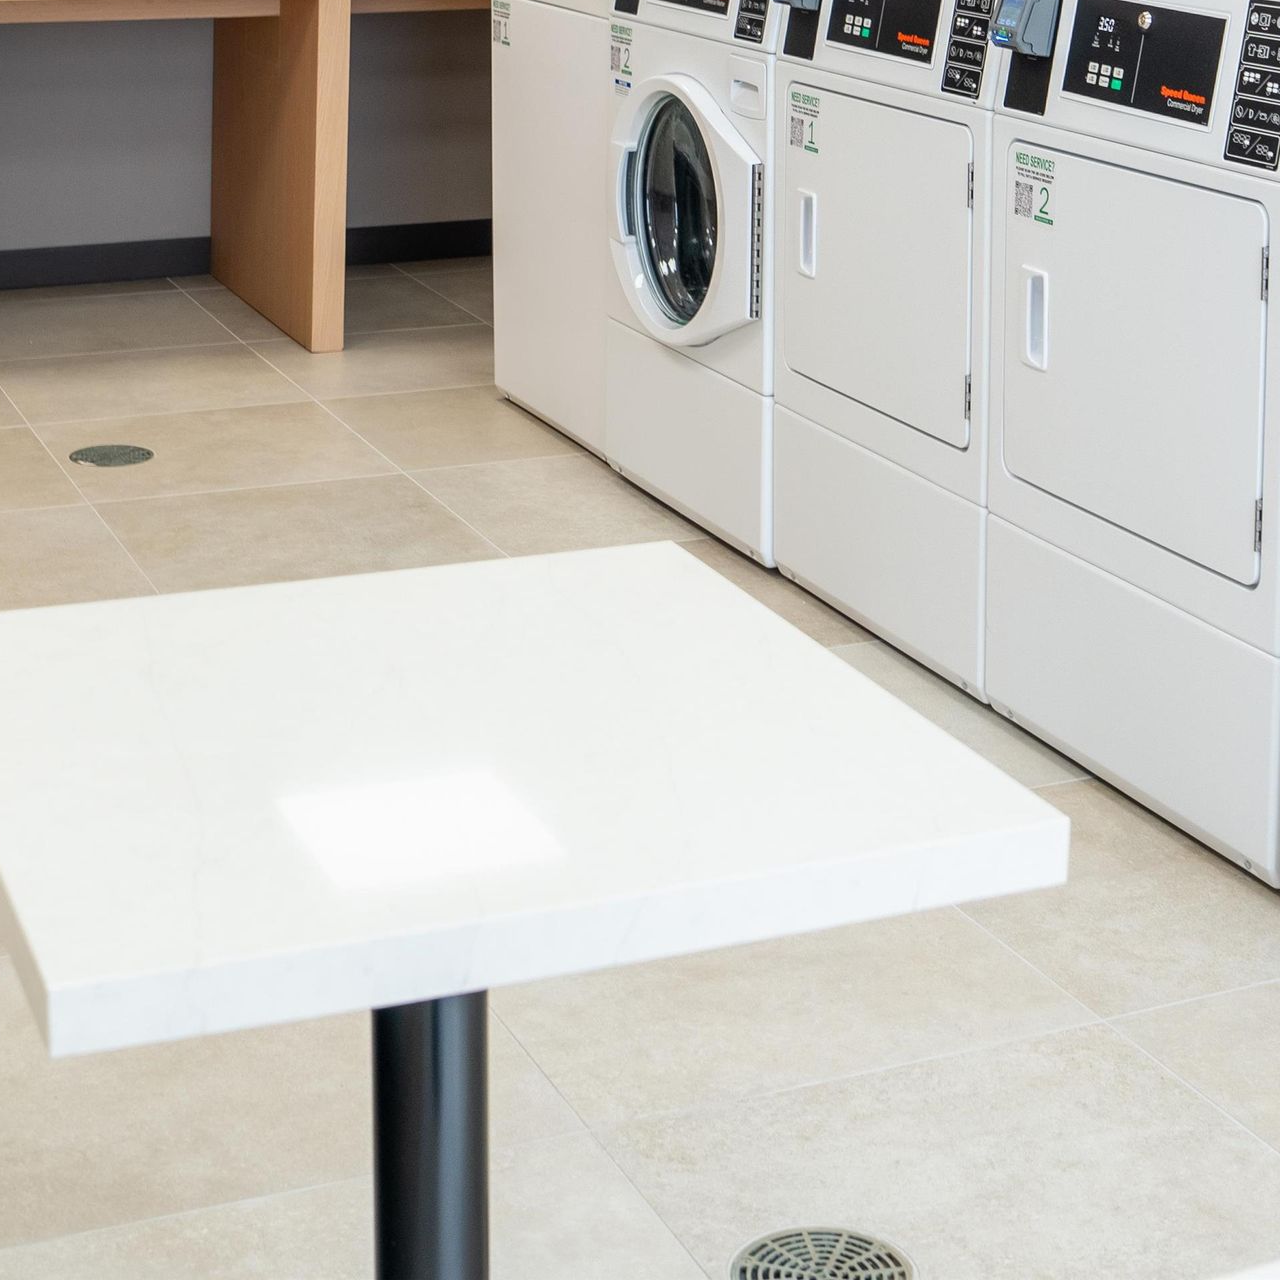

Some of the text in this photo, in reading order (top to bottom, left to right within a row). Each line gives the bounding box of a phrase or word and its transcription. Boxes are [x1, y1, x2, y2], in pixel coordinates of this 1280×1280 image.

[624, 48, 630, 69] 2
[1161, 85, 1206, 105] Speed Queen
[1167, 98, 1204, 115] Commercial Dryer
[808, 121, 815, 145] 1
[1015, 151, 1029, 165] NEED
[1039, 187, 1050, 215] 2
